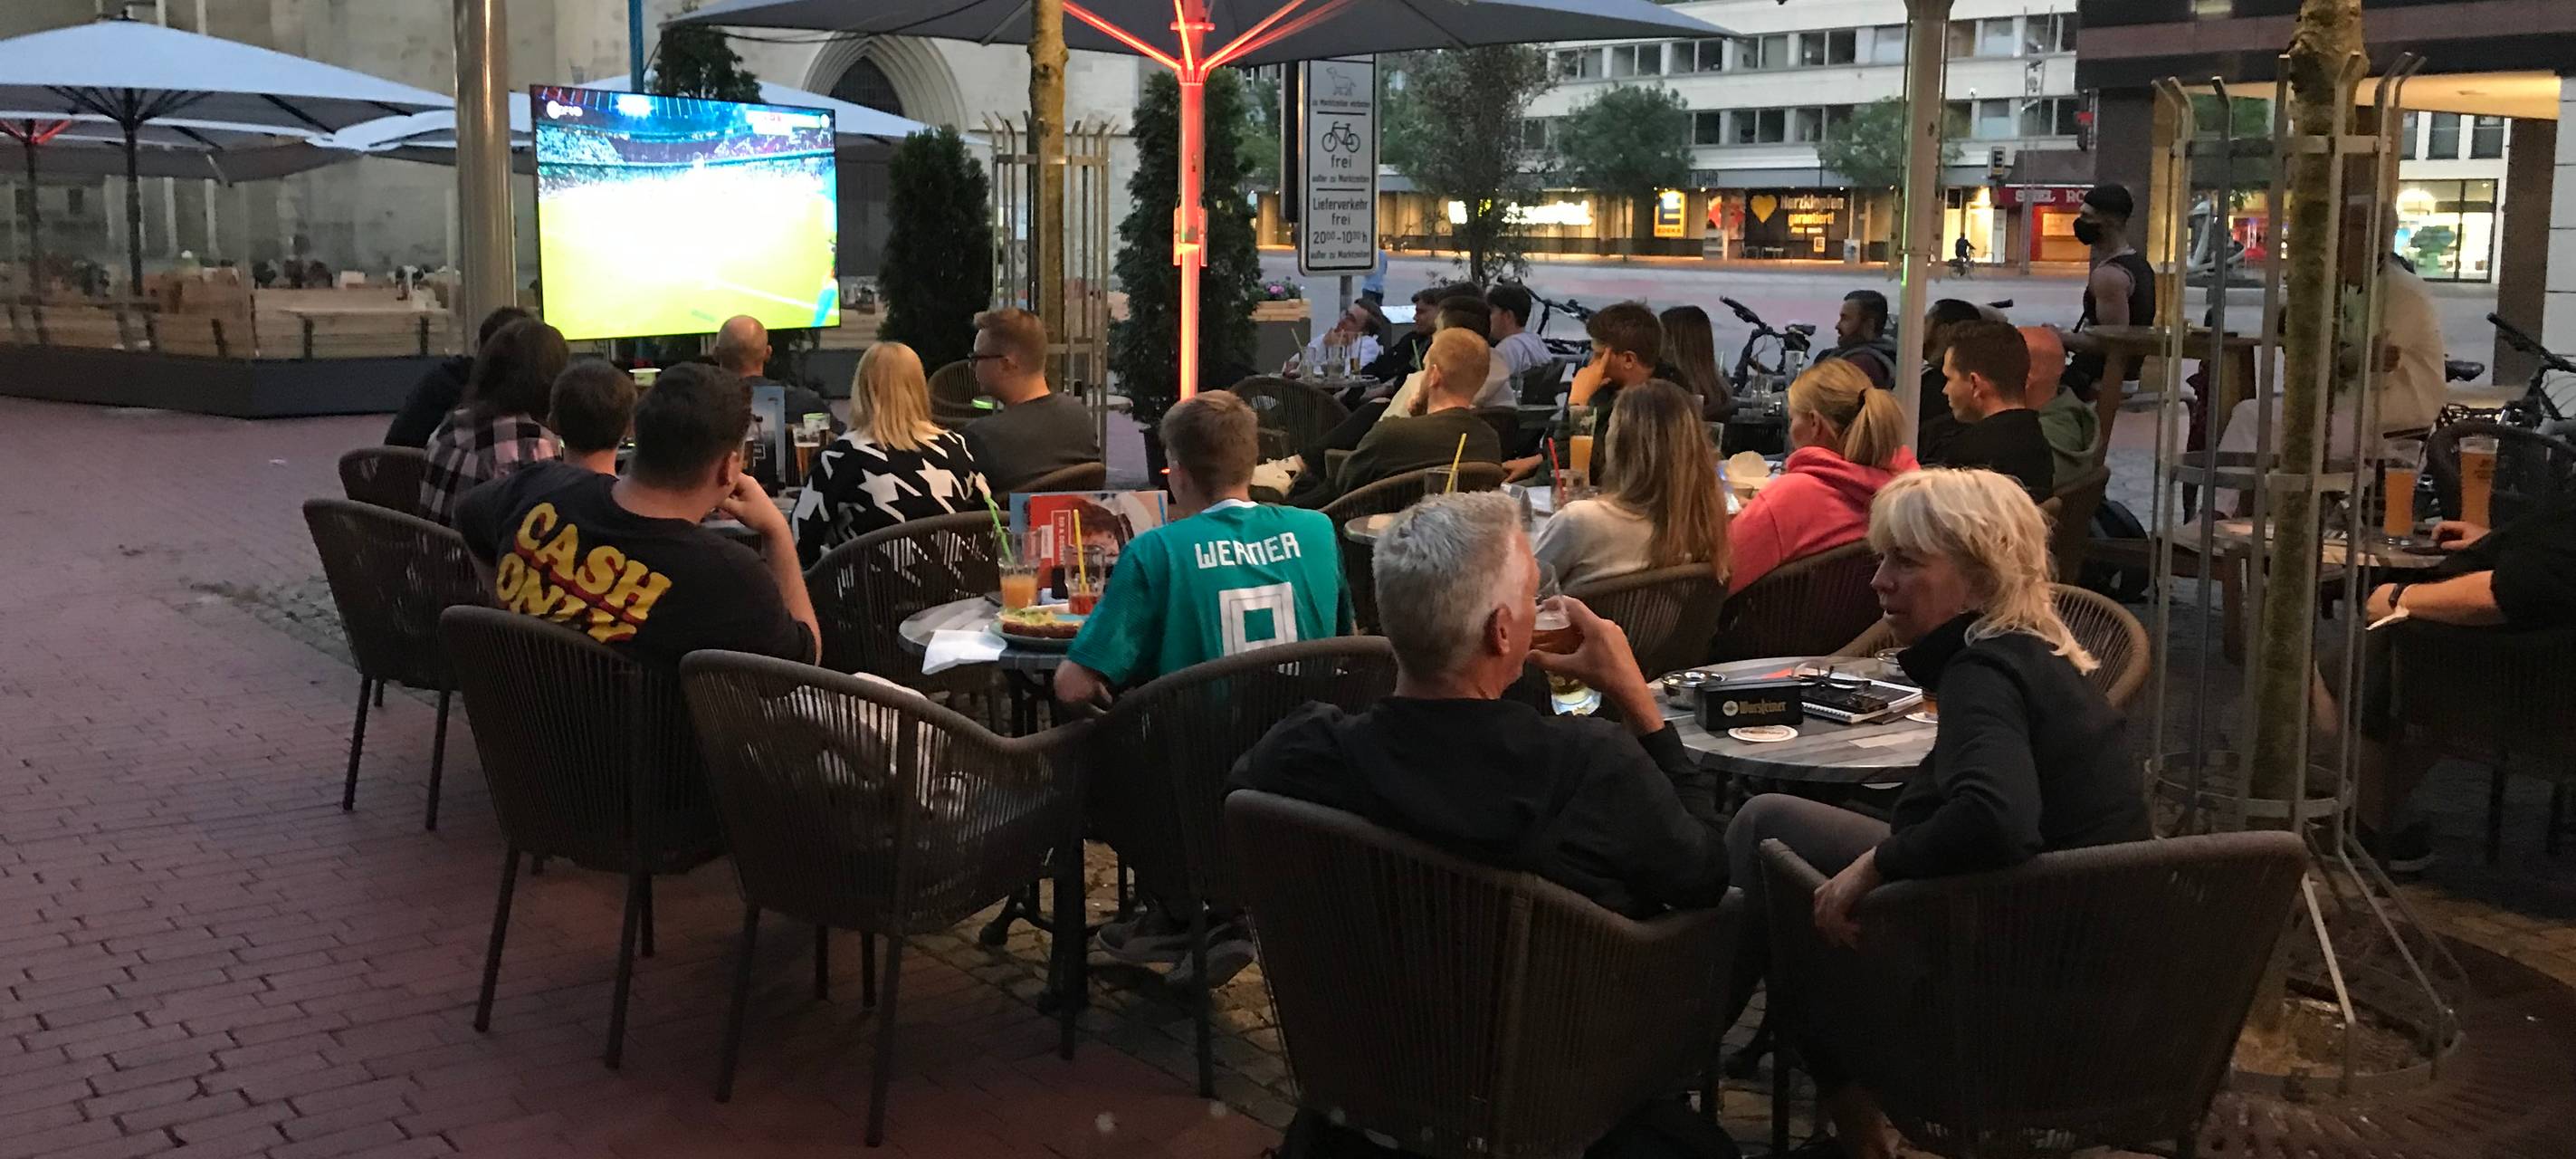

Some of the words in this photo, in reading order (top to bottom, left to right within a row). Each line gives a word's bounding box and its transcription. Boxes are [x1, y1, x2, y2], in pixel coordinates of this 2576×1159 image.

[1331, 154, 1352, 168] frei
[1312, 197, 1368, 210] Lieferverkehr
[1779, 194, 1845, 212] Herzklopfen
[1331, 212, 1351, 225] frei
[1788, 211, 1835, 227] garantiert!
[1194, 531, 1302, 570] WERNER
[516, 502, 673, 621] CASH
[1739, 697, 1787, 714] Warsteiner
